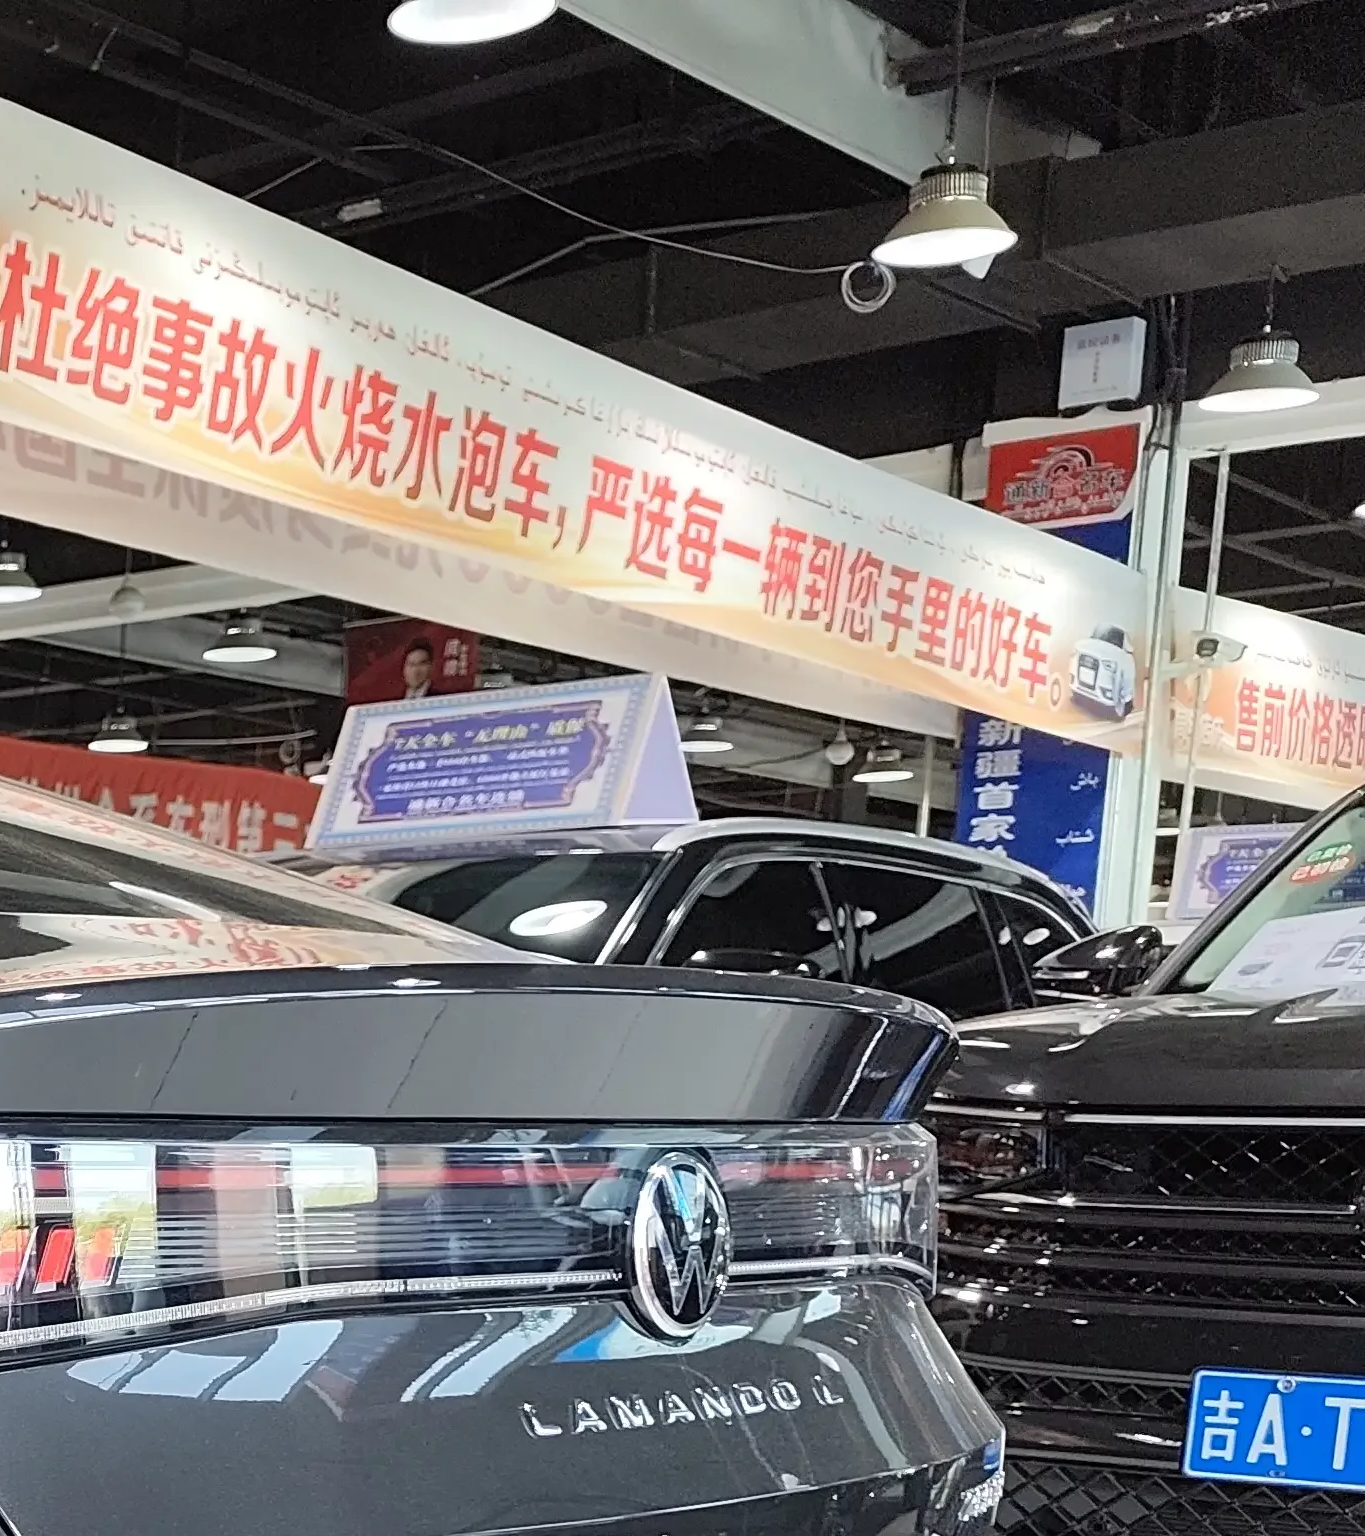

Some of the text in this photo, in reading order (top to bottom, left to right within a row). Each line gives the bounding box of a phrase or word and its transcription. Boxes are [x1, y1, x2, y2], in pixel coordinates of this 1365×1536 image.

[968, 719, 1023, 858] 新疆首家
[521, 1377, 803, 1438] LAMANDO
